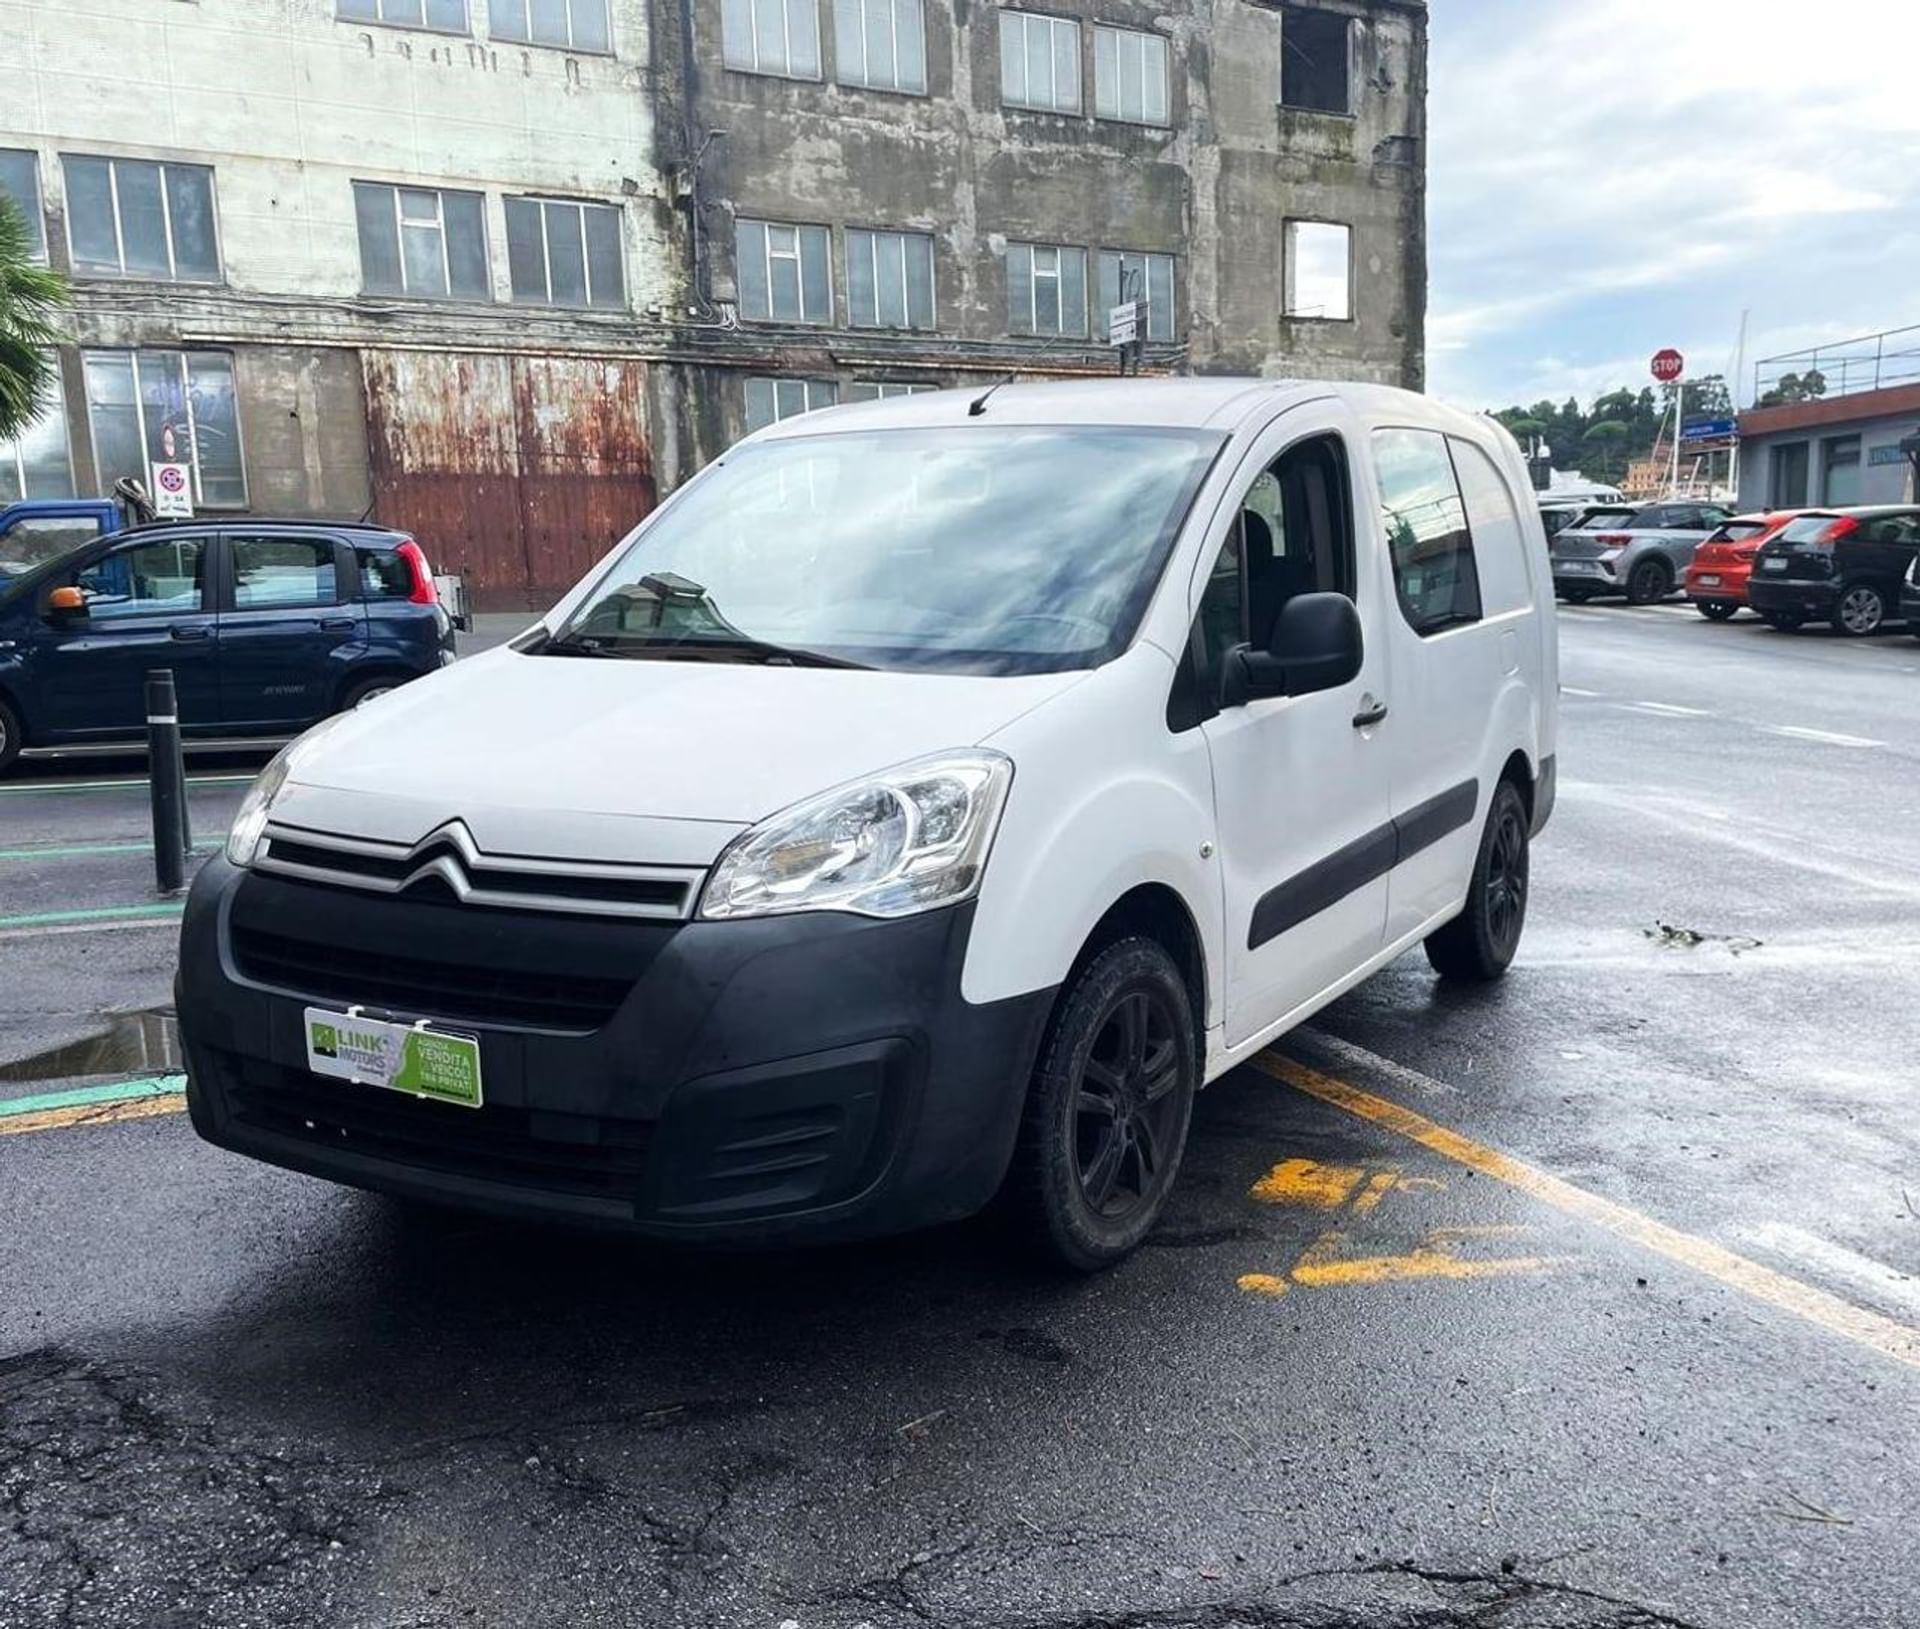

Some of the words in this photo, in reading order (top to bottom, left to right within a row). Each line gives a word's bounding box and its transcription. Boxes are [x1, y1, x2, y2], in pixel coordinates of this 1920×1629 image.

[1653, 359, 1681, 373] STOP
[337, 1029, 383, 1052] LINK
[338, 1046, 386, 1069] MOTORS
[417, 1046, 471, 1067] VENDITA
